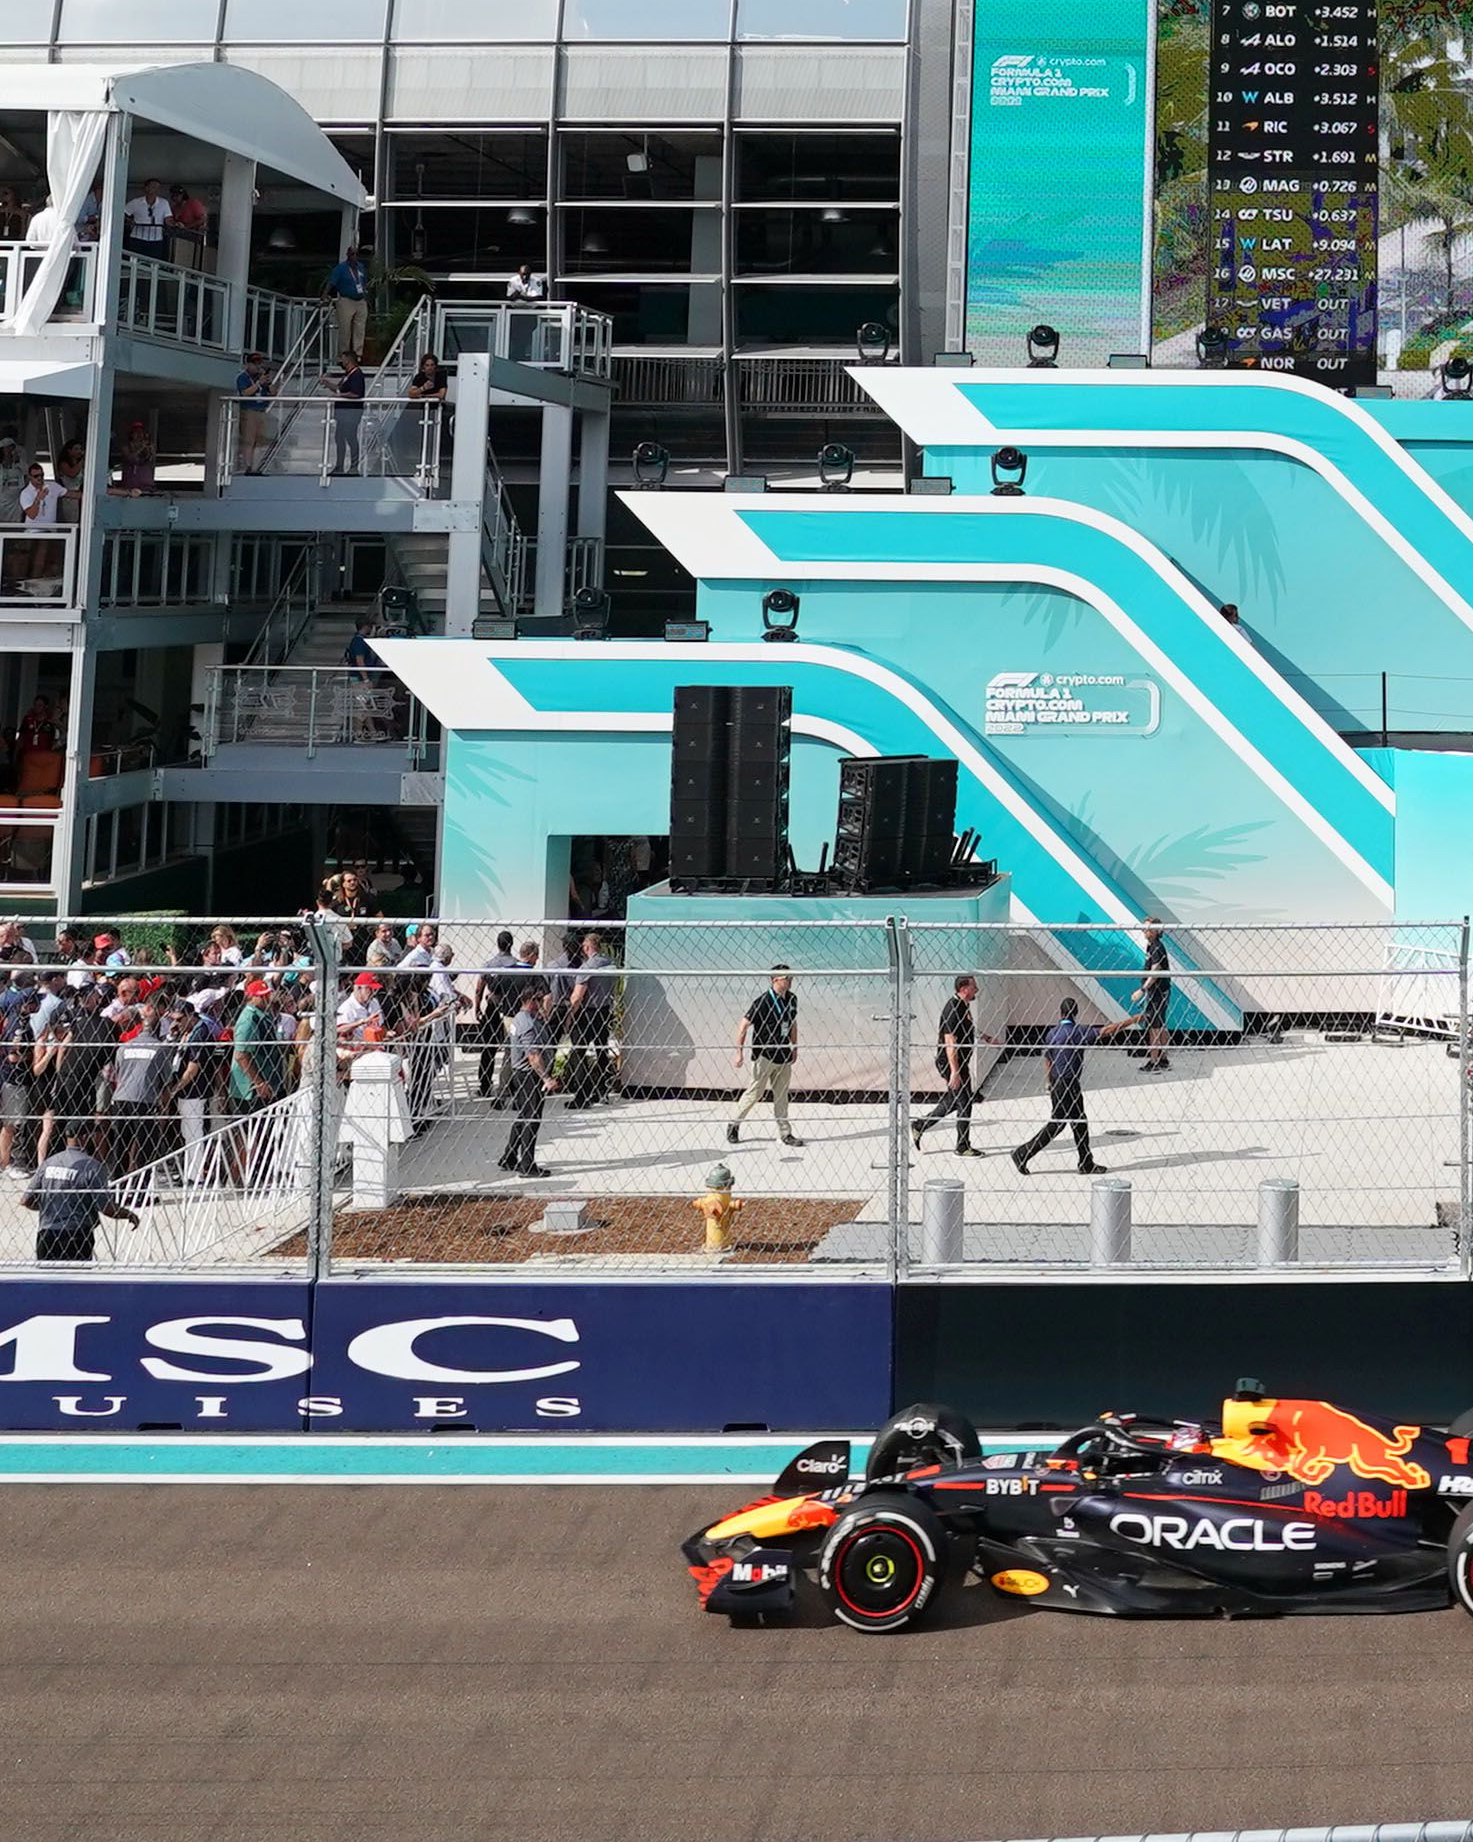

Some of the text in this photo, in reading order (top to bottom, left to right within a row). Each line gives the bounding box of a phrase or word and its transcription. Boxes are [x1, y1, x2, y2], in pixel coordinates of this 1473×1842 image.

[1266, 6, 1296, 18] BOT
[1266, 34, 1296, 47] ALO
[1264, 63, 1296, 76] OCO
[1264, 92, 1294, 104] ALB
[1264, 121, 1287, 134] RIC
[1263, 150, 1293, 163] STR
[1263, 179, 1299, 192] MAG
[1263, 209, 1292, 221] TSU
[1262, 238, 1292, 250] LAT
[1262, 267, 1295, 280] MSC
[1262, 297, 1348, 310] VET OUT
[1261, 327, 1347, 341] GAS OUT
[1261, 357, 1347, 371] NOR OUT
[1056, 675, 1123, 685] crypto.com
[986, 688, 1061, 699] FORMULA
[986, 700, 1083, 710] CRYPTO.COM
[986, 712, 1128, 723] MIAMI GRAND PRIX
[1444, 1437, 1471, 1465] 1
[796, 1457, 841, 1474] Claro
[985, 1476, 1040, 1496] BYBIT
[1304, 1489, 1408, 1519] Red Bull
[1109, 1513, 1317, 1551] ORACLE
